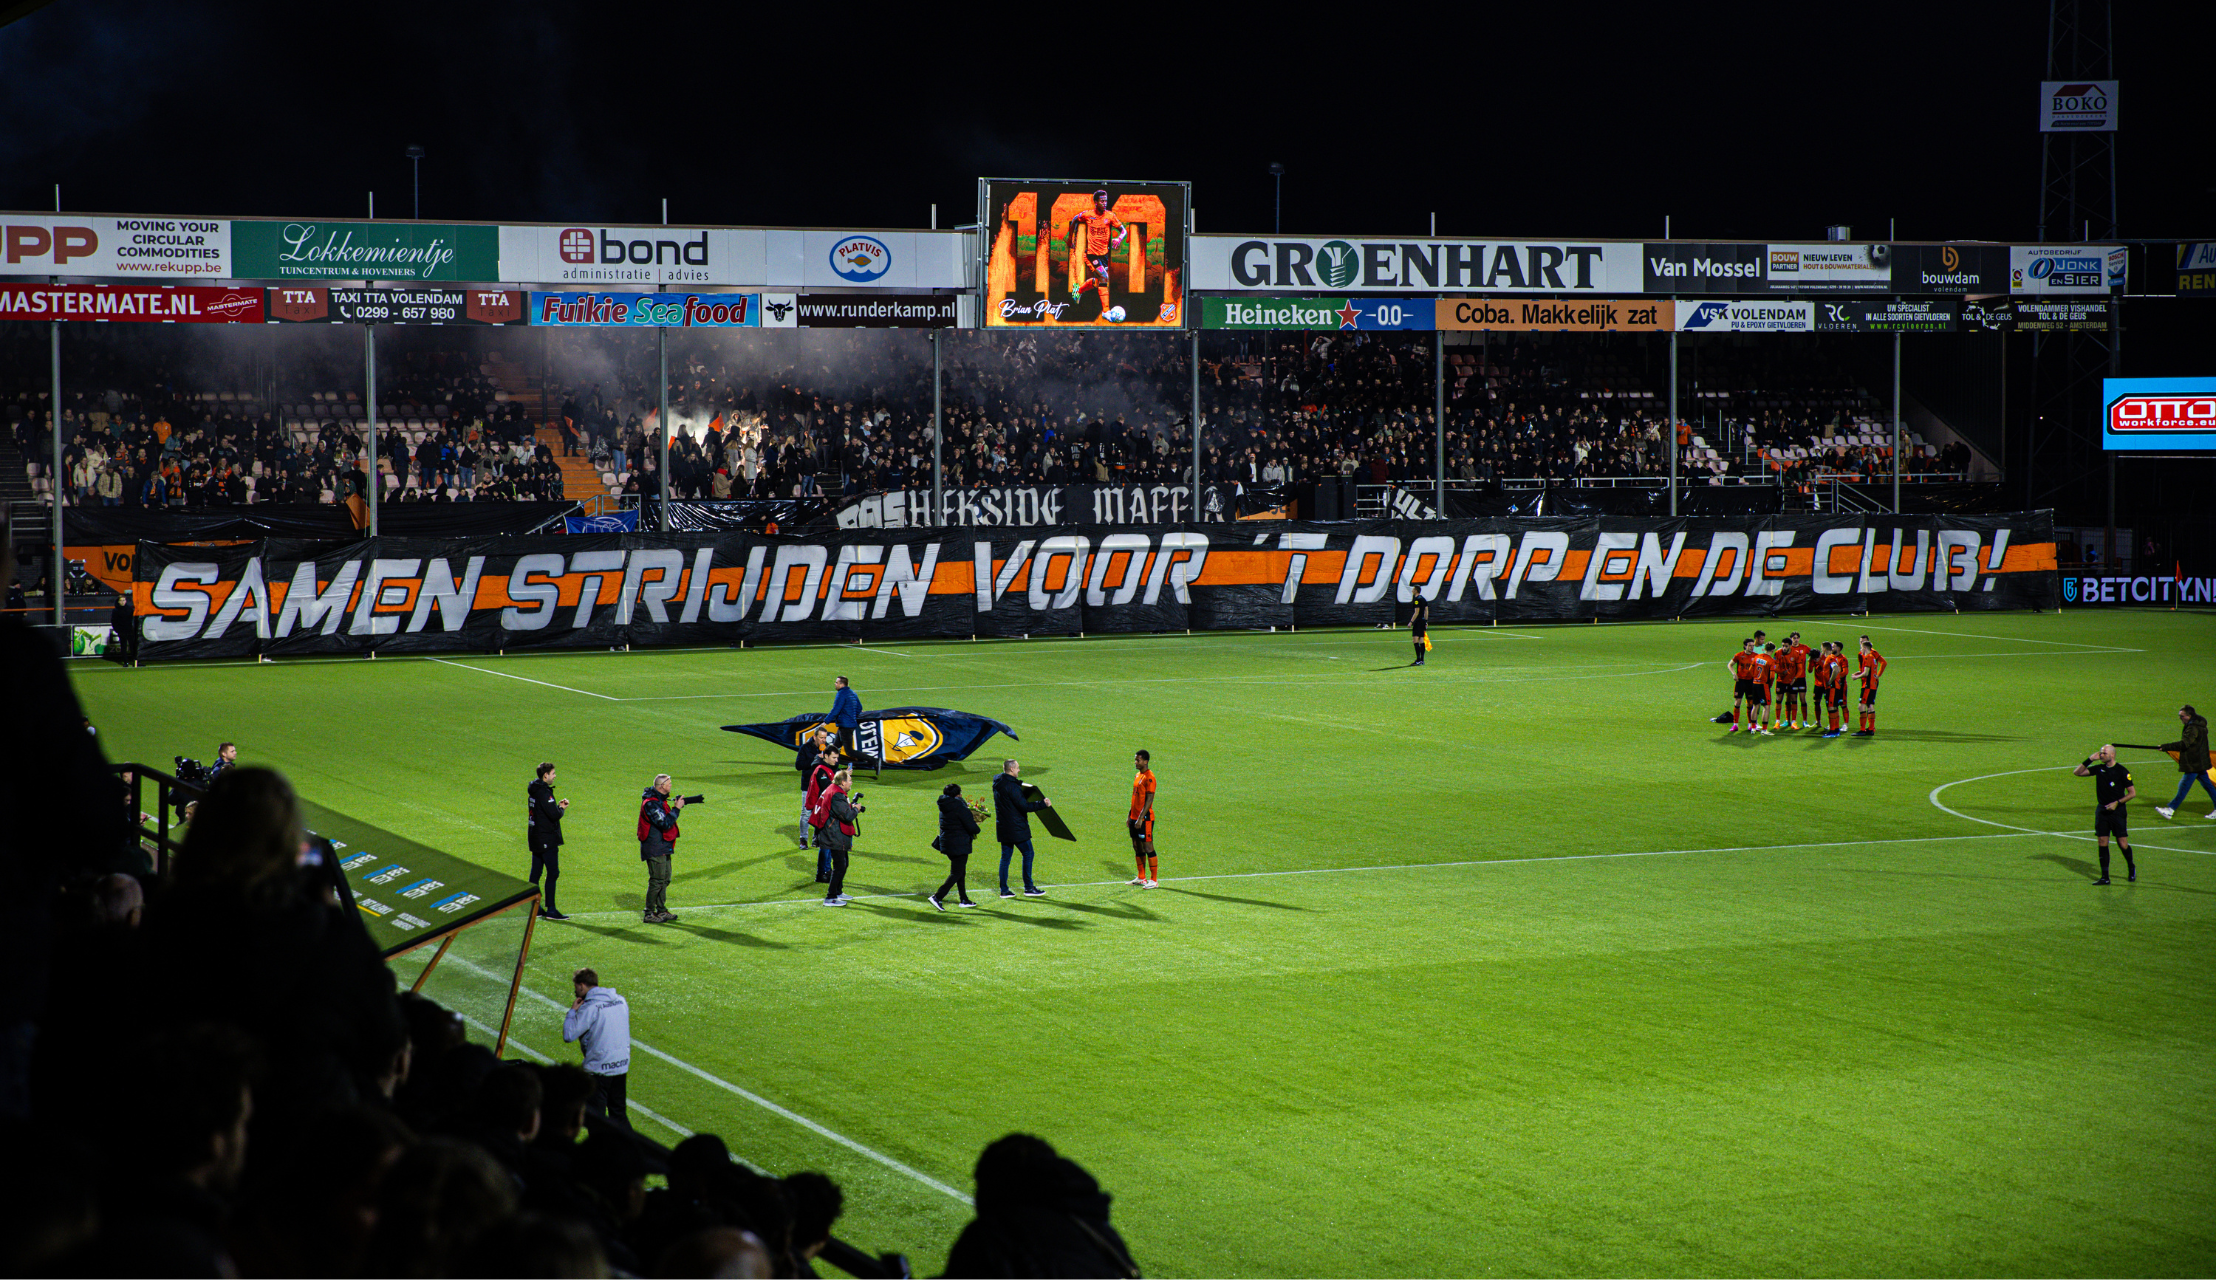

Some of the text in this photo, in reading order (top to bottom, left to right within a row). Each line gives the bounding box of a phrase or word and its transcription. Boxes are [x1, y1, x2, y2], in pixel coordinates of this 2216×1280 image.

[2052, 96, 2107, 111] BOKO
[116, 220, 219, 233] MOVING YOUR
[0, 225, 99, 265] PP
[132, 234, 205, 246] CIRCULAR
[117, 246, 220, 259] COMMODITIES
[279, 223, 454, 278] Lokkemientje
[600, 228, 709, 266] bond
[838, 242, 882, 258] PLATVIS
[1772, 253, 1853, 262] BOUW NIEUW LEVEN
[116, 261, 222, 275] www.rekupp.be
[279, 266, 416, 276] TUINCENTRUM & HOVENIERS
[1650, 257, 1761, 278] Van Mossel
[2056, 259, 2099, 271] JONK
[563, 268, 709, 281] administratie advies
[1921, 270, 1980, 284] bouwdam
[2064, 273, 2099, 285] SIER
[283, 290, 316, 304] TTA
[331, 292, 463, 305] TAXI TTA VOLENDAM
[478, 293, 510, 306] TTA
[206, 298, 258, 312] MASTERMATE
[283, 304, 317, 315] Taxi
[541, 295, 748, 327] Fuikie Seafood
[799, 301, 956, 322] www.runderkamp.nl
[998, 298, 1032, 318] Brian
[1886, 304, 1930, 313] UW SPECIALIST
[2017, 304, 2108, 313] VOLENDAMMER VISHANDEL
[356, 306, 389, 319] 0299
[402, 307, 426, 319] 657
[430, 307, 455, 320] 980
[478, 307, 510, 317] Taxi
[1225, 303, 1333, 326] Heineken
[1455, 302, 1658, 329] Coba. Makkelijk zat
[1700, 307, 1806, 320] VSK VOLENDAM
[1824, 303, 1851, 322] RC
[1865, 313, 1951, 321] IN ALLE SOORTEN GIETVLOEREN
[1961, 313, 2013, 321] TOL & DE GEUS
[2038, 312, 2087, 320] TOL & DE GEUS
[1746, 321, 1766, 329] EPOXY
[1767, 321, 1806, 329] GIETVLOEREN
[1870, 322, 1947, 330] www.rcvloeren.nl
[2118, 400, 2216, 419] OTTO
[2118, 418, 2216, 427] workforce.eu
[1092, 485, 1225, 524] MAFFA
[142, 555, 486, 642] SAMEN
[501, 543, 941, 631] STRIJDEN
[974, 532, 1210, 613] VOOR
[1334, 531, 1569, 605] DORP
[1579, 531, 1688, 601] EN
[1690, 530, 1797, 597] DE
[1812, 527, 2011, 594] CLUB!
